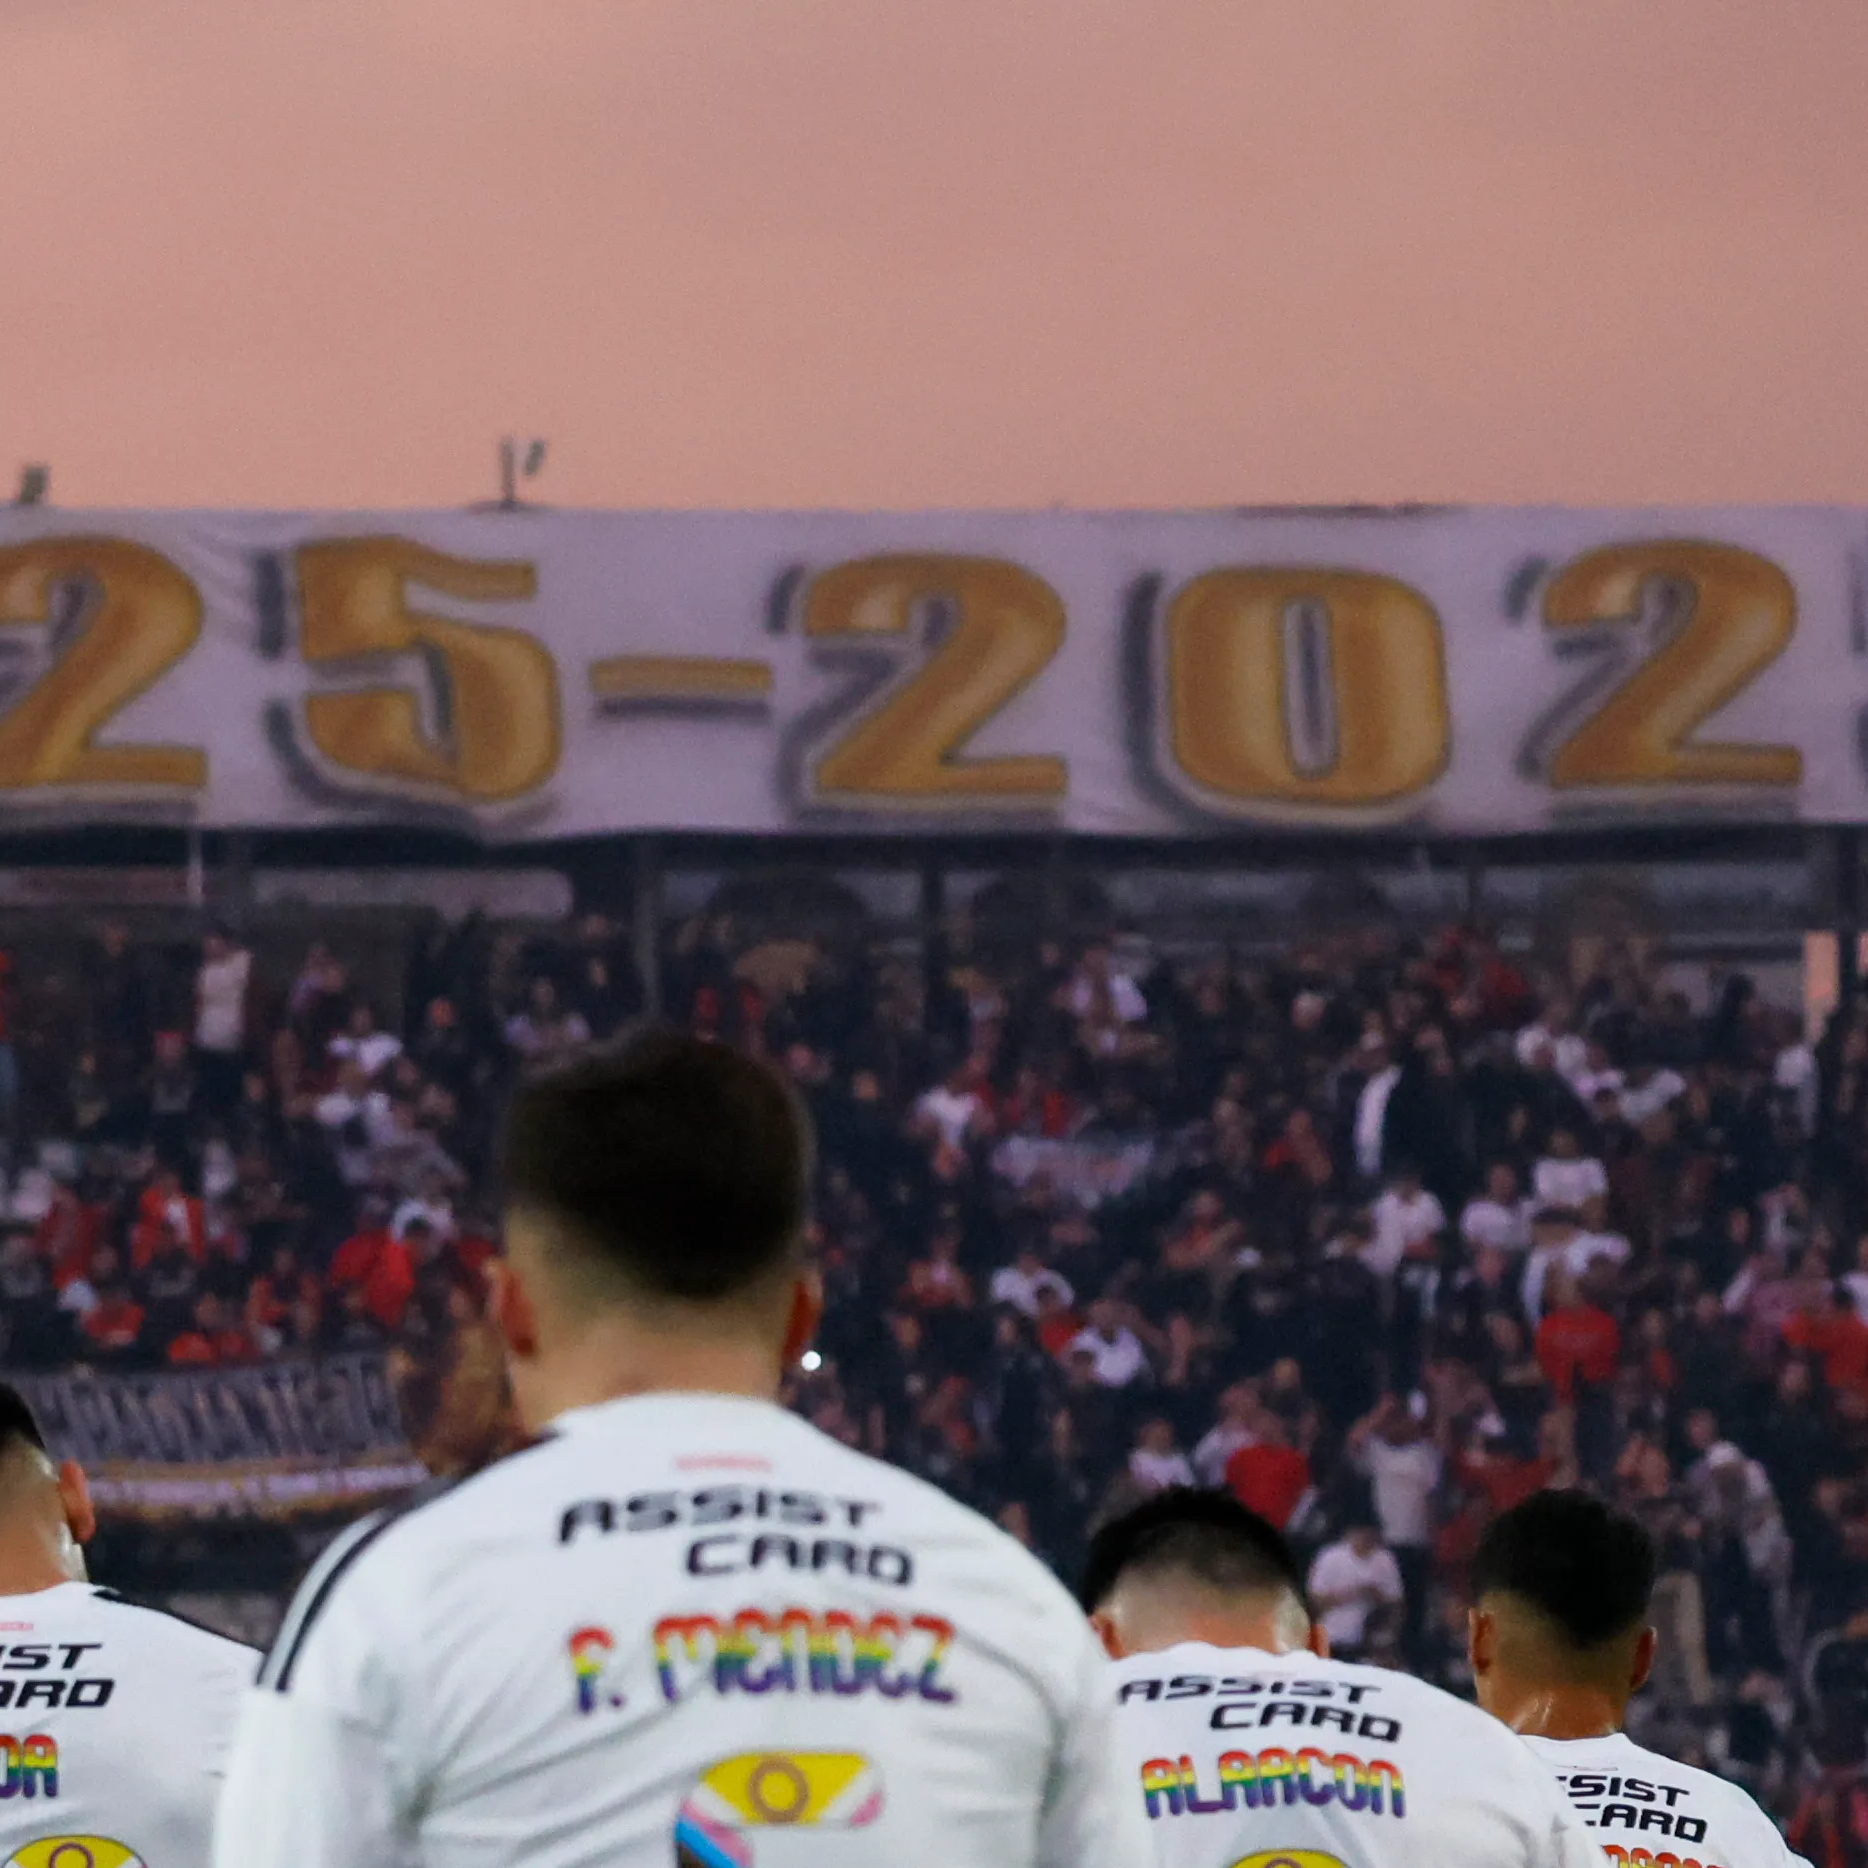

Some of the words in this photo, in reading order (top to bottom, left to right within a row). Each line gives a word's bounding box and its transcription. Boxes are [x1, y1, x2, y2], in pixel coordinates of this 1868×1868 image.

[558, 1484, 883, 1546] ASSIST
[684, 1532, 917, 1590] CARD
[652, 1607, 962, 1707] MENDEZ
[1117, 1673, 1384, 1706] ASSIST
[1208, 1702, 1403, 1743] CARD
[1140, 1747, 1407, 1819] ALARCON
[1556, 1775, 1690, 1807] SIST
